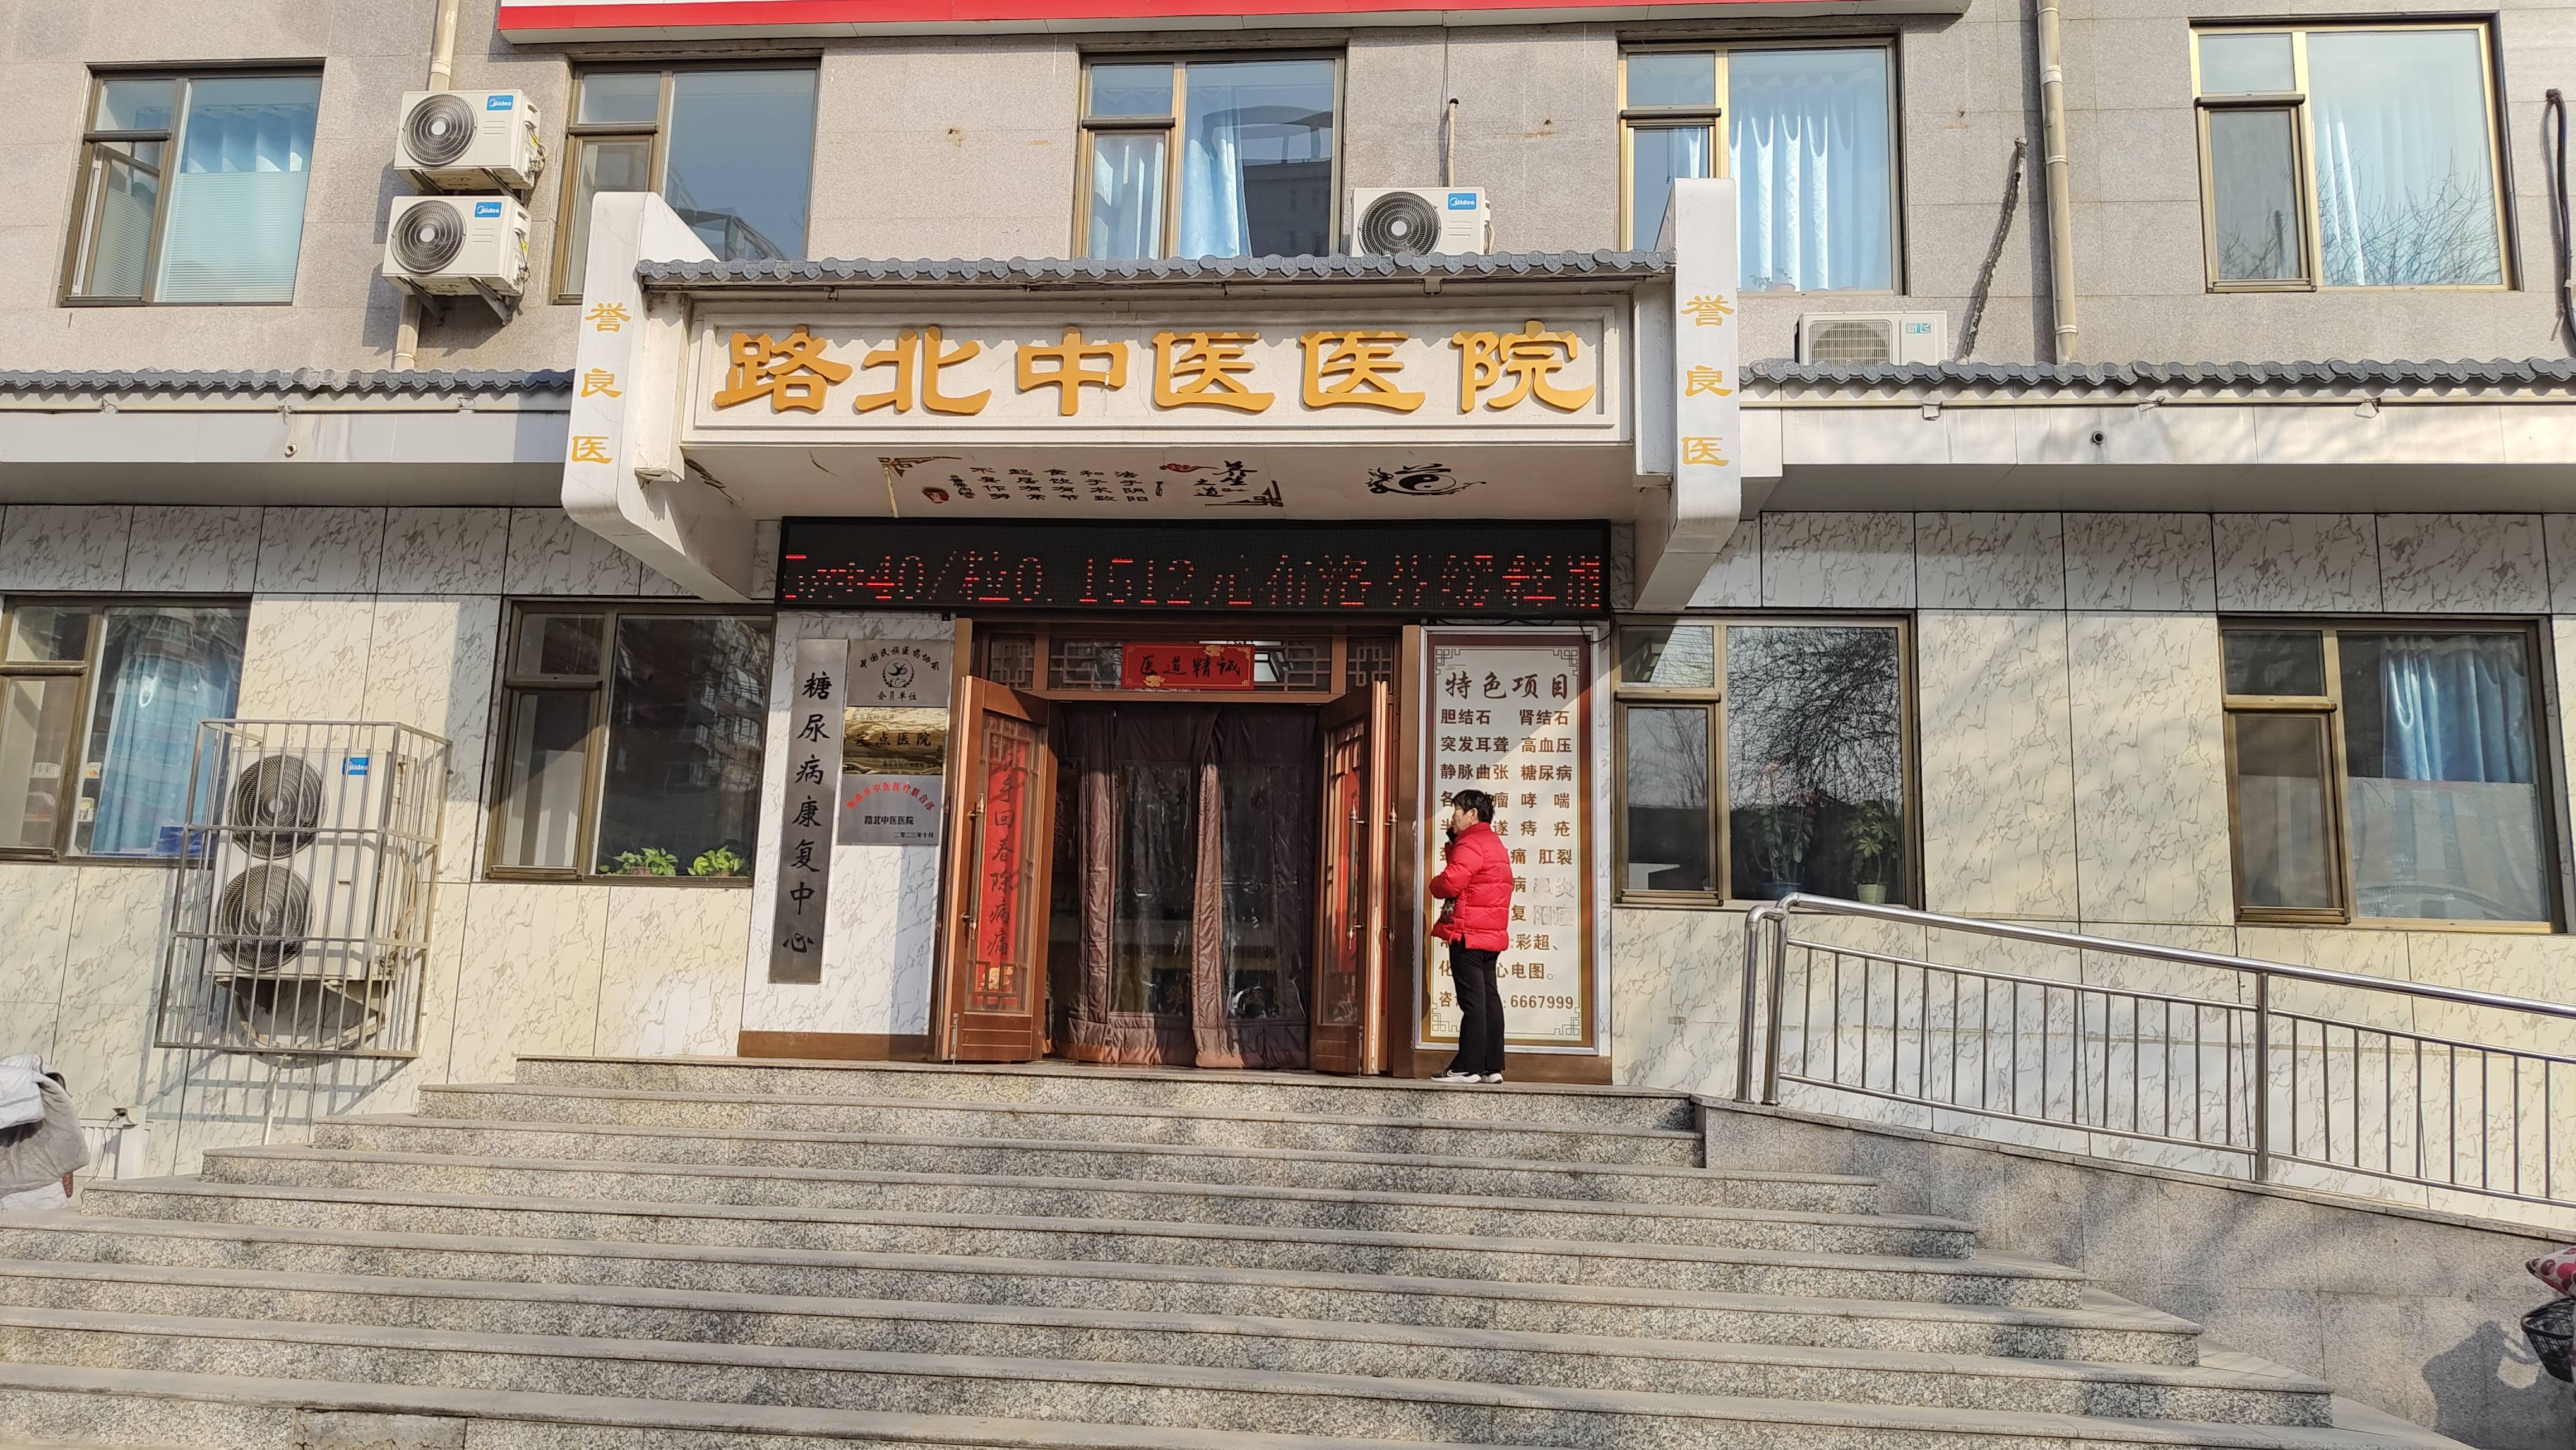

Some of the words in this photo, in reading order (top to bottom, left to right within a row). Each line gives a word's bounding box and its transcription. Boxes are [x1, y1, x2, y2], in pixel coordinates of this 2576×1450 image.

[489, 98, 512, 107] Midea
[477, 205, 499, 215] Midea
[1450, 197, 1475, 206] Midea
[1906, 323, 1931, 333] 新飞
[714, 321, 1597, 416] 路北中医医院
[571, 302, 632, 464] 誉良医
[1680, 294, 1735, 467] 誉良医
[1114, 471, 1148, 501] 法于阴阳
[1140, 655, 1241, 678] 医道精诚
[1445, 670, 1568, 700] 特色项目
[877, 690, 917, 702] 会员单位
[1440, 709, 1491, 726] 胆结石
[1519, 709, 1570, 726] 肾结石
[856, 731, 931, 746] 定点医院
[1440, 735, 1510, 753] 突发耳聋
[1521, 736, 1572, 753] 高血压
[1440, 763, 1509, 781] 静脉曲张
[1520, 764, 1572, 781] 糖尿病
[1521, 792, 1570, 809] 哮喘
[783, 671, 832, 953] 糖尿病康复中心
[864, 815, 915, 825] 路北中医医院
[1520, 820, 1570, 837] 痔疮
[1539, 848, 1573, 865] 肛裂
